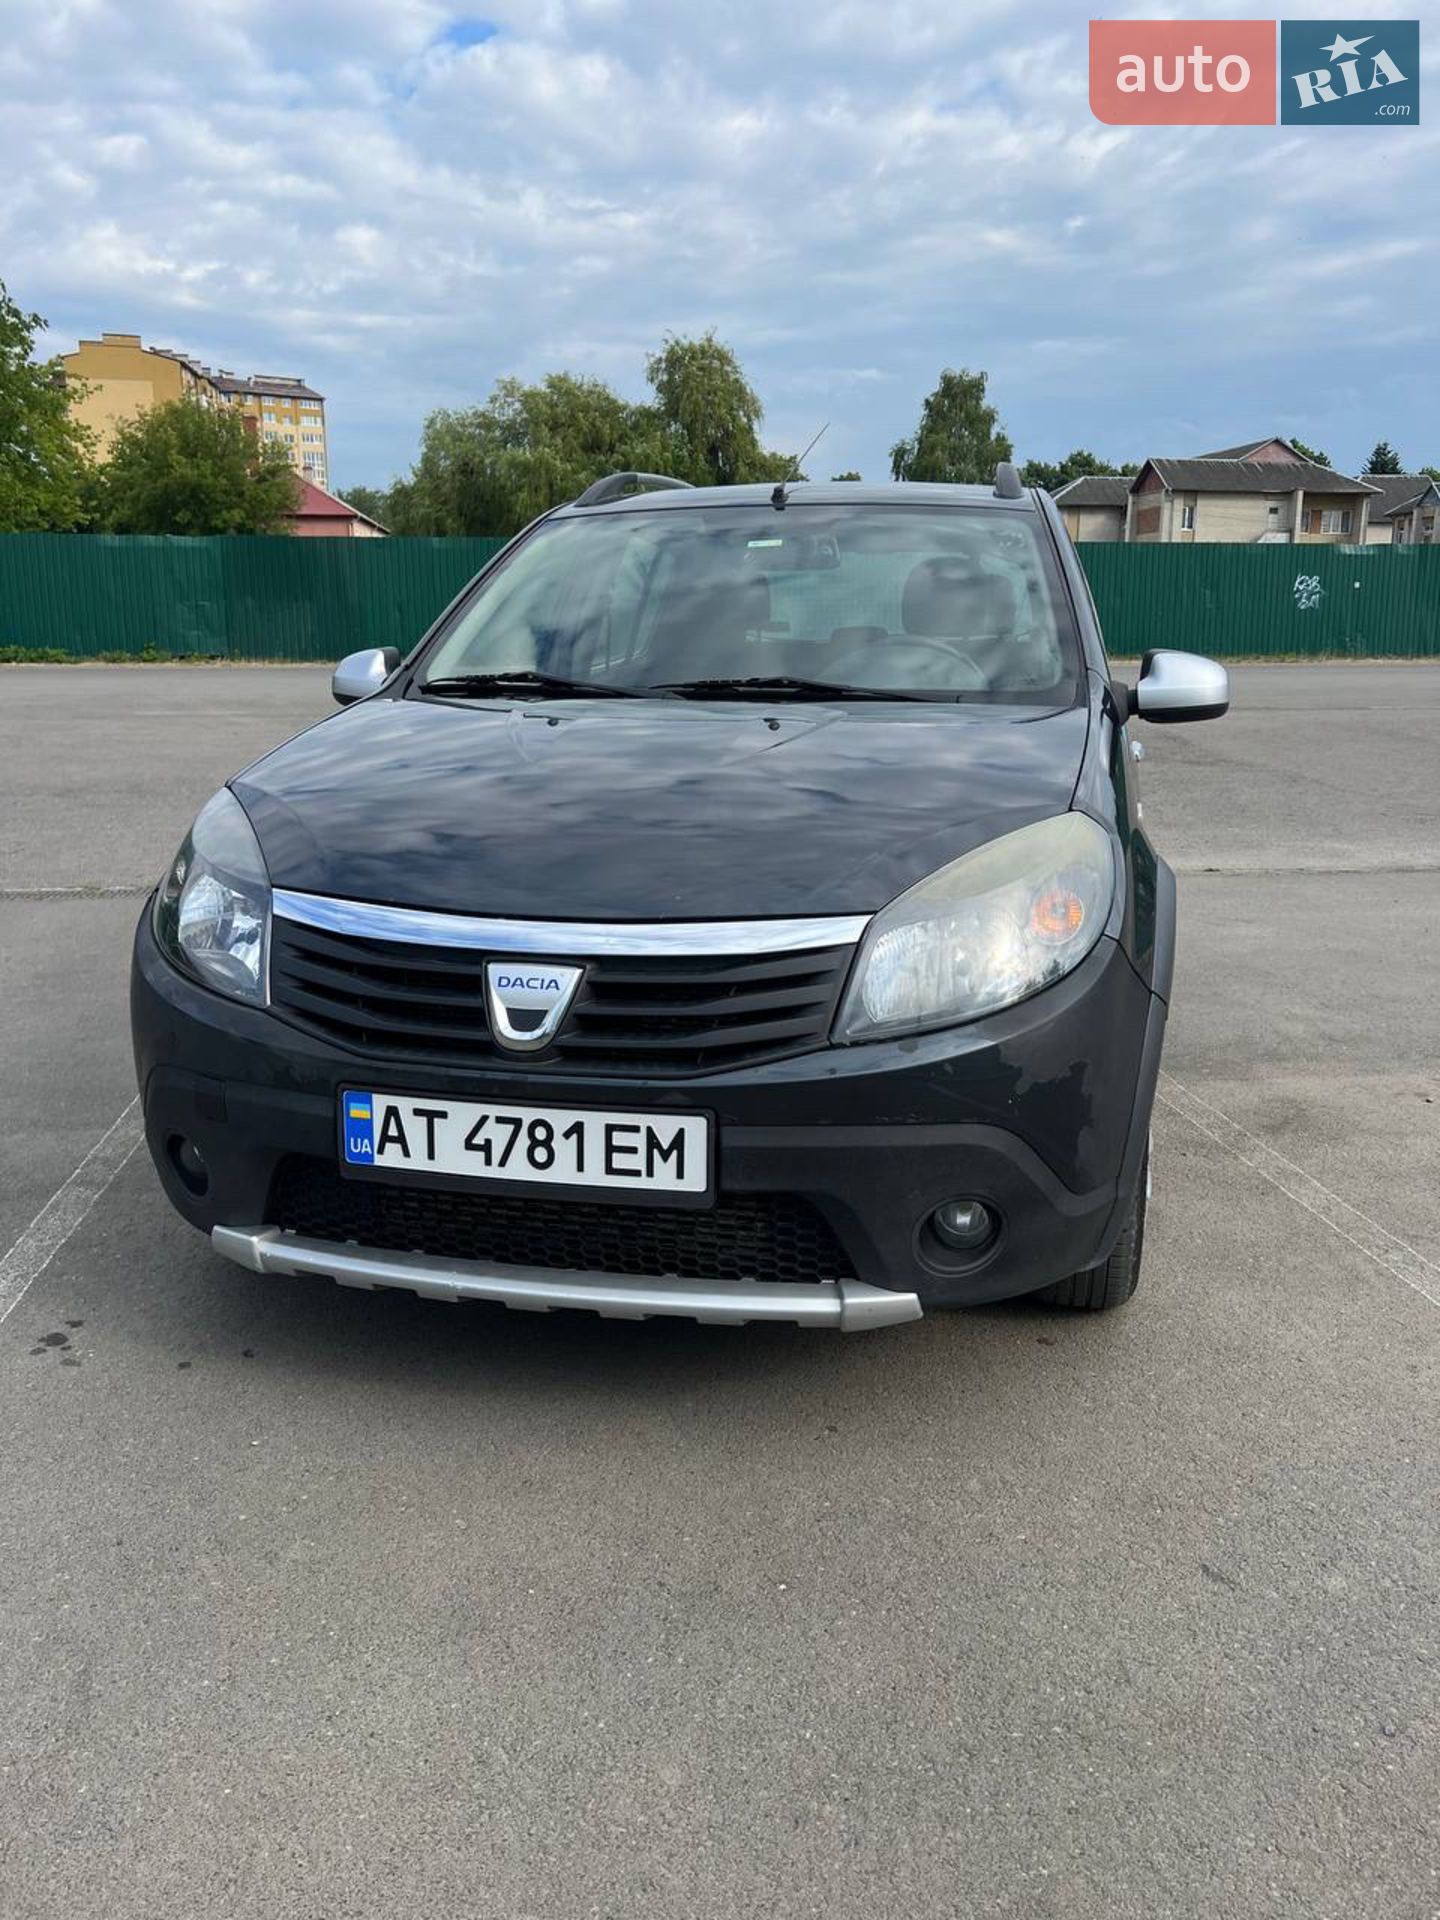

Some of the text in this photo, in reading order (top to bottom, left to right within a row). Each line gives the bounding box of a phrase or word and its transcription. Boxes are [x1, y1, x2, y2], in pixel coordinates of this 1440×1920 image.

[497, 976, 560, 991] DACIA
[350, 1137, 372, 1155] UA
[376, 1105, 686, 1180] AT 4781 EM
